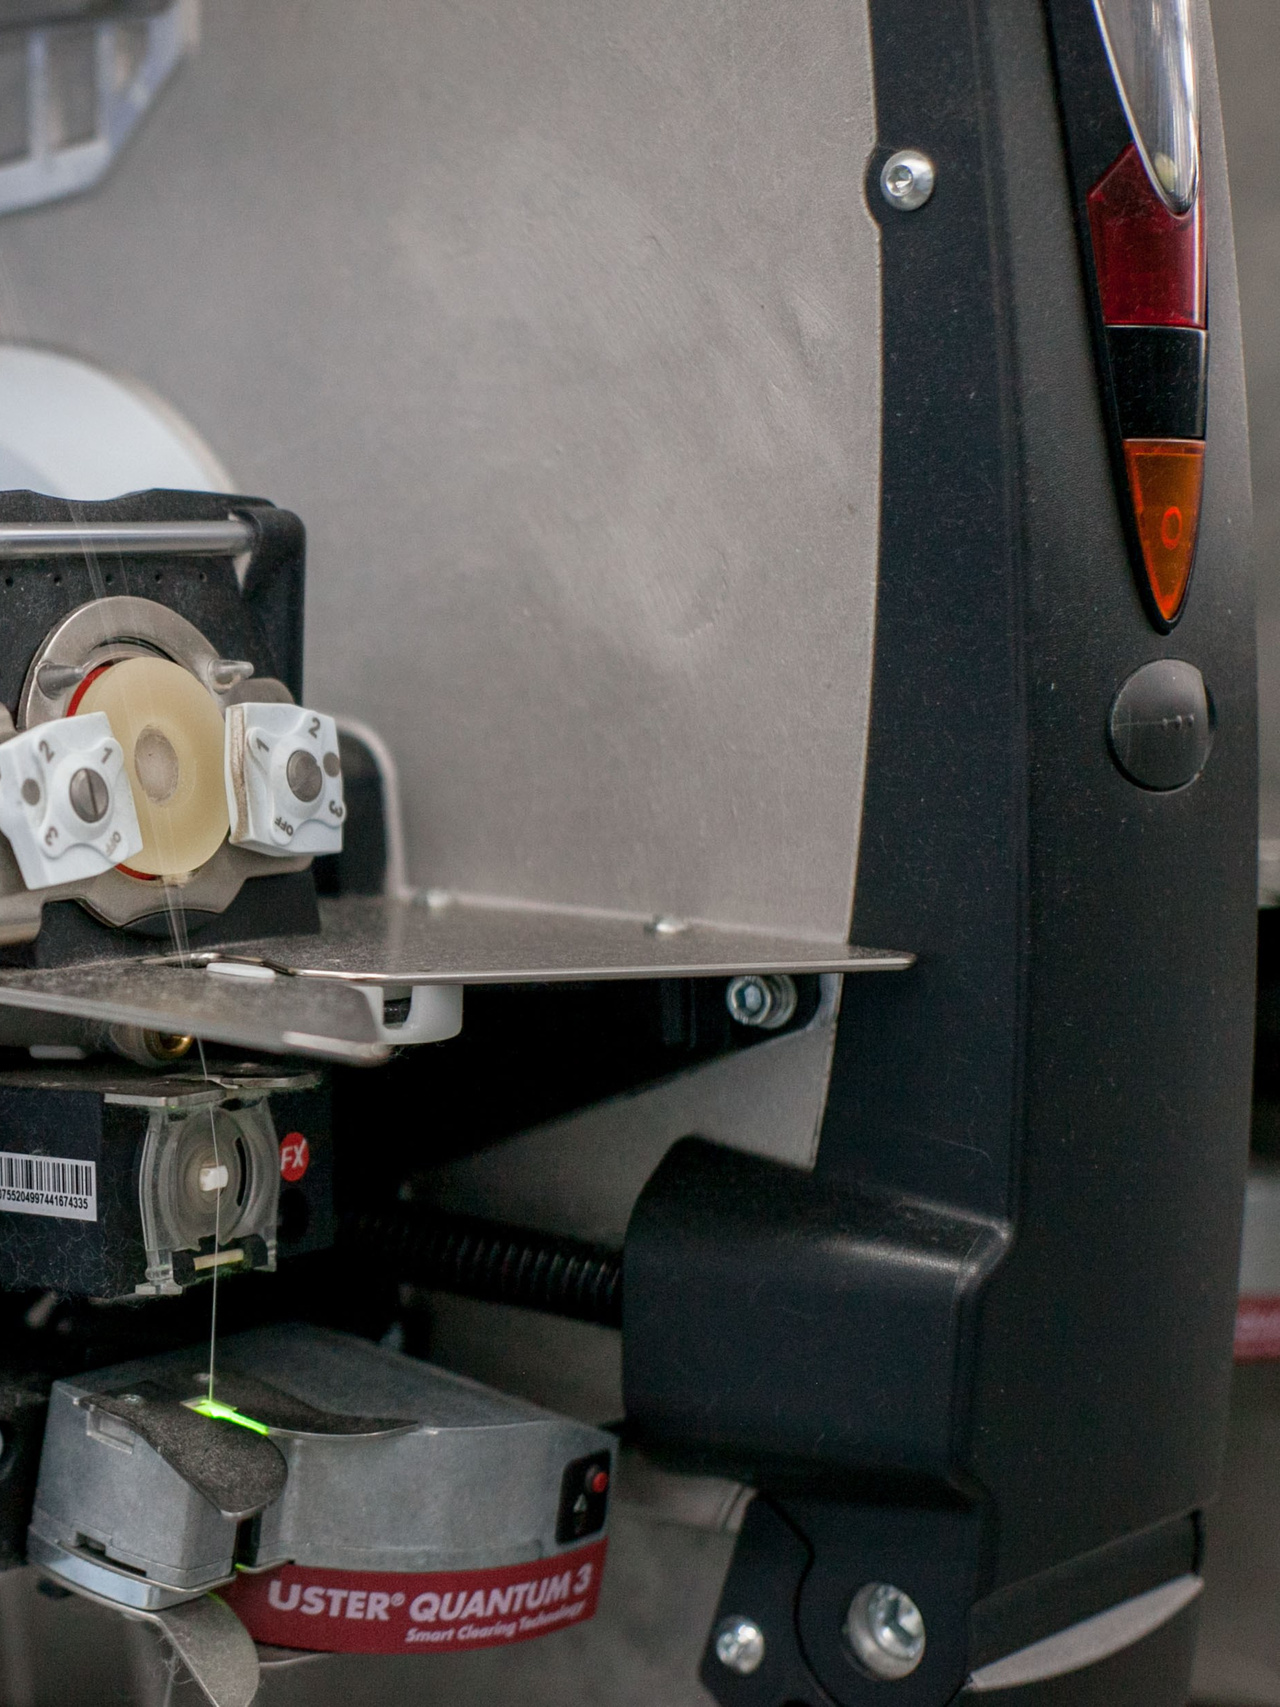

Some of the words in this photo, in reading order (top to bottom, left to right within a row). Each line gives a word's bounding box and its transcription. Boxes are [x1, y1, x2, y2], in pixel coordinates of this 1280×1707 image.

[307, 716, 321, 739] 2
[38, 740, 56, 763] 2
[101, 746, 114, 764] 1
[255, 736, 270, 753] 1
[328, 800, 343, 818] 3
[44, 825, 59, 847] 3
[274, 816, 294, 837] OFF
[280, 1138, 307, 1170] FX
[408, 1570, 573, 1623] QUANTUM
[572, 1562, 593, 1596] 3
[404, 1627, 456, 1643] Smart
[456, 1620, 518, 1640] Clearing
